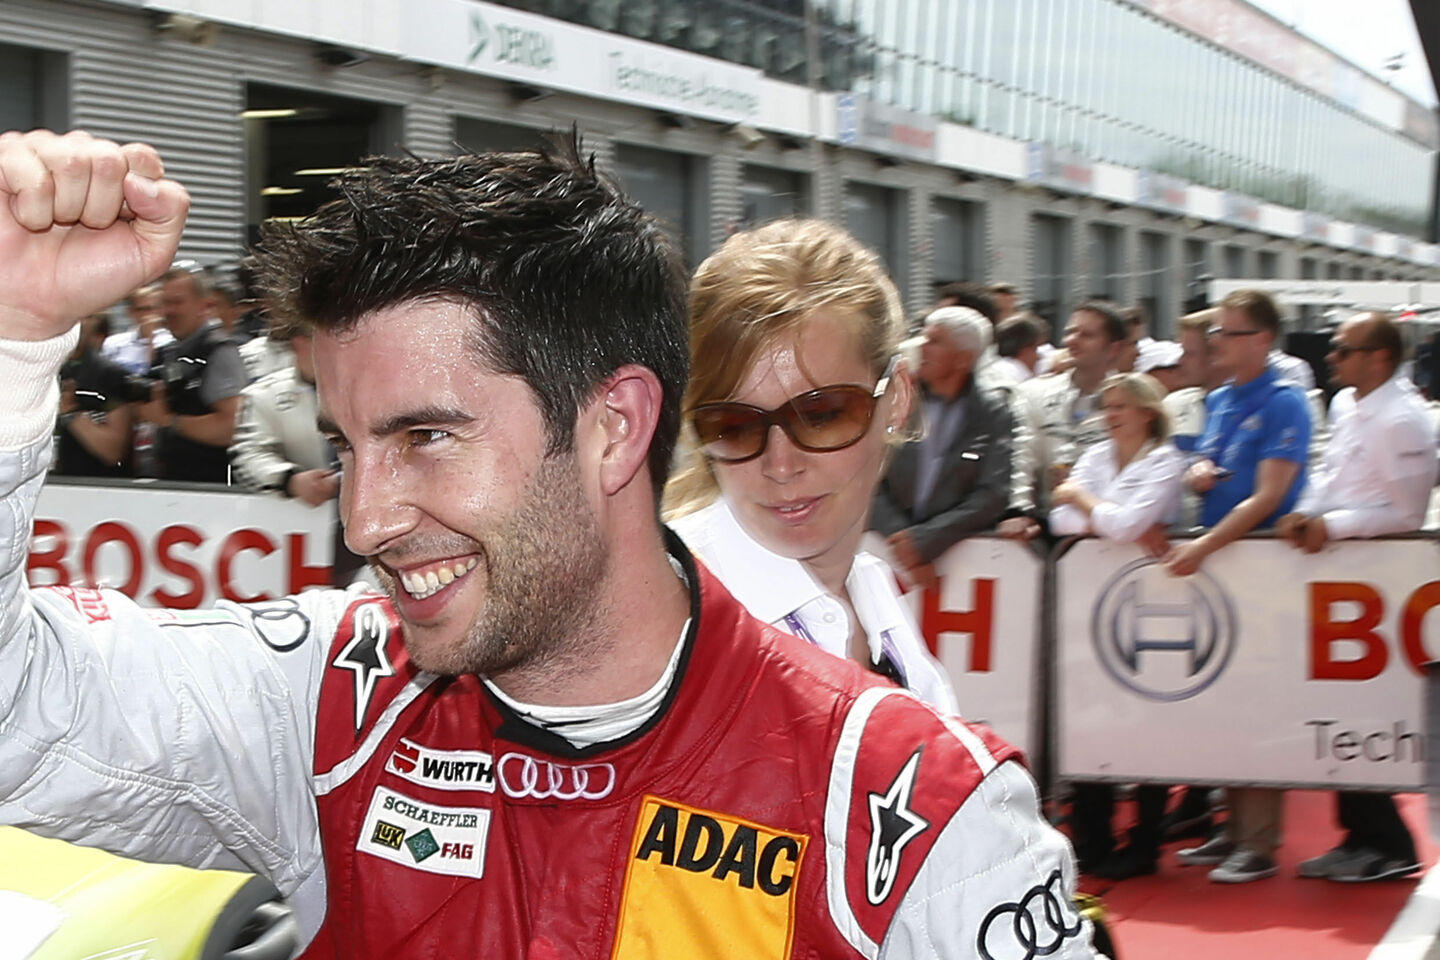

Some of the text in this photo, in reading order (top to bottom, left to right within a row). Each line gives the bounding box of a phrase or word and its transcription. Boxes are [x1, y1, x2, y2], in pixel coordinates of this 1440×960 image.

[382, 795, 479, 829] SCHAEFFLER
[440, 842, 475, 860] FAG
[636, 805, 799, 896] ADAC
